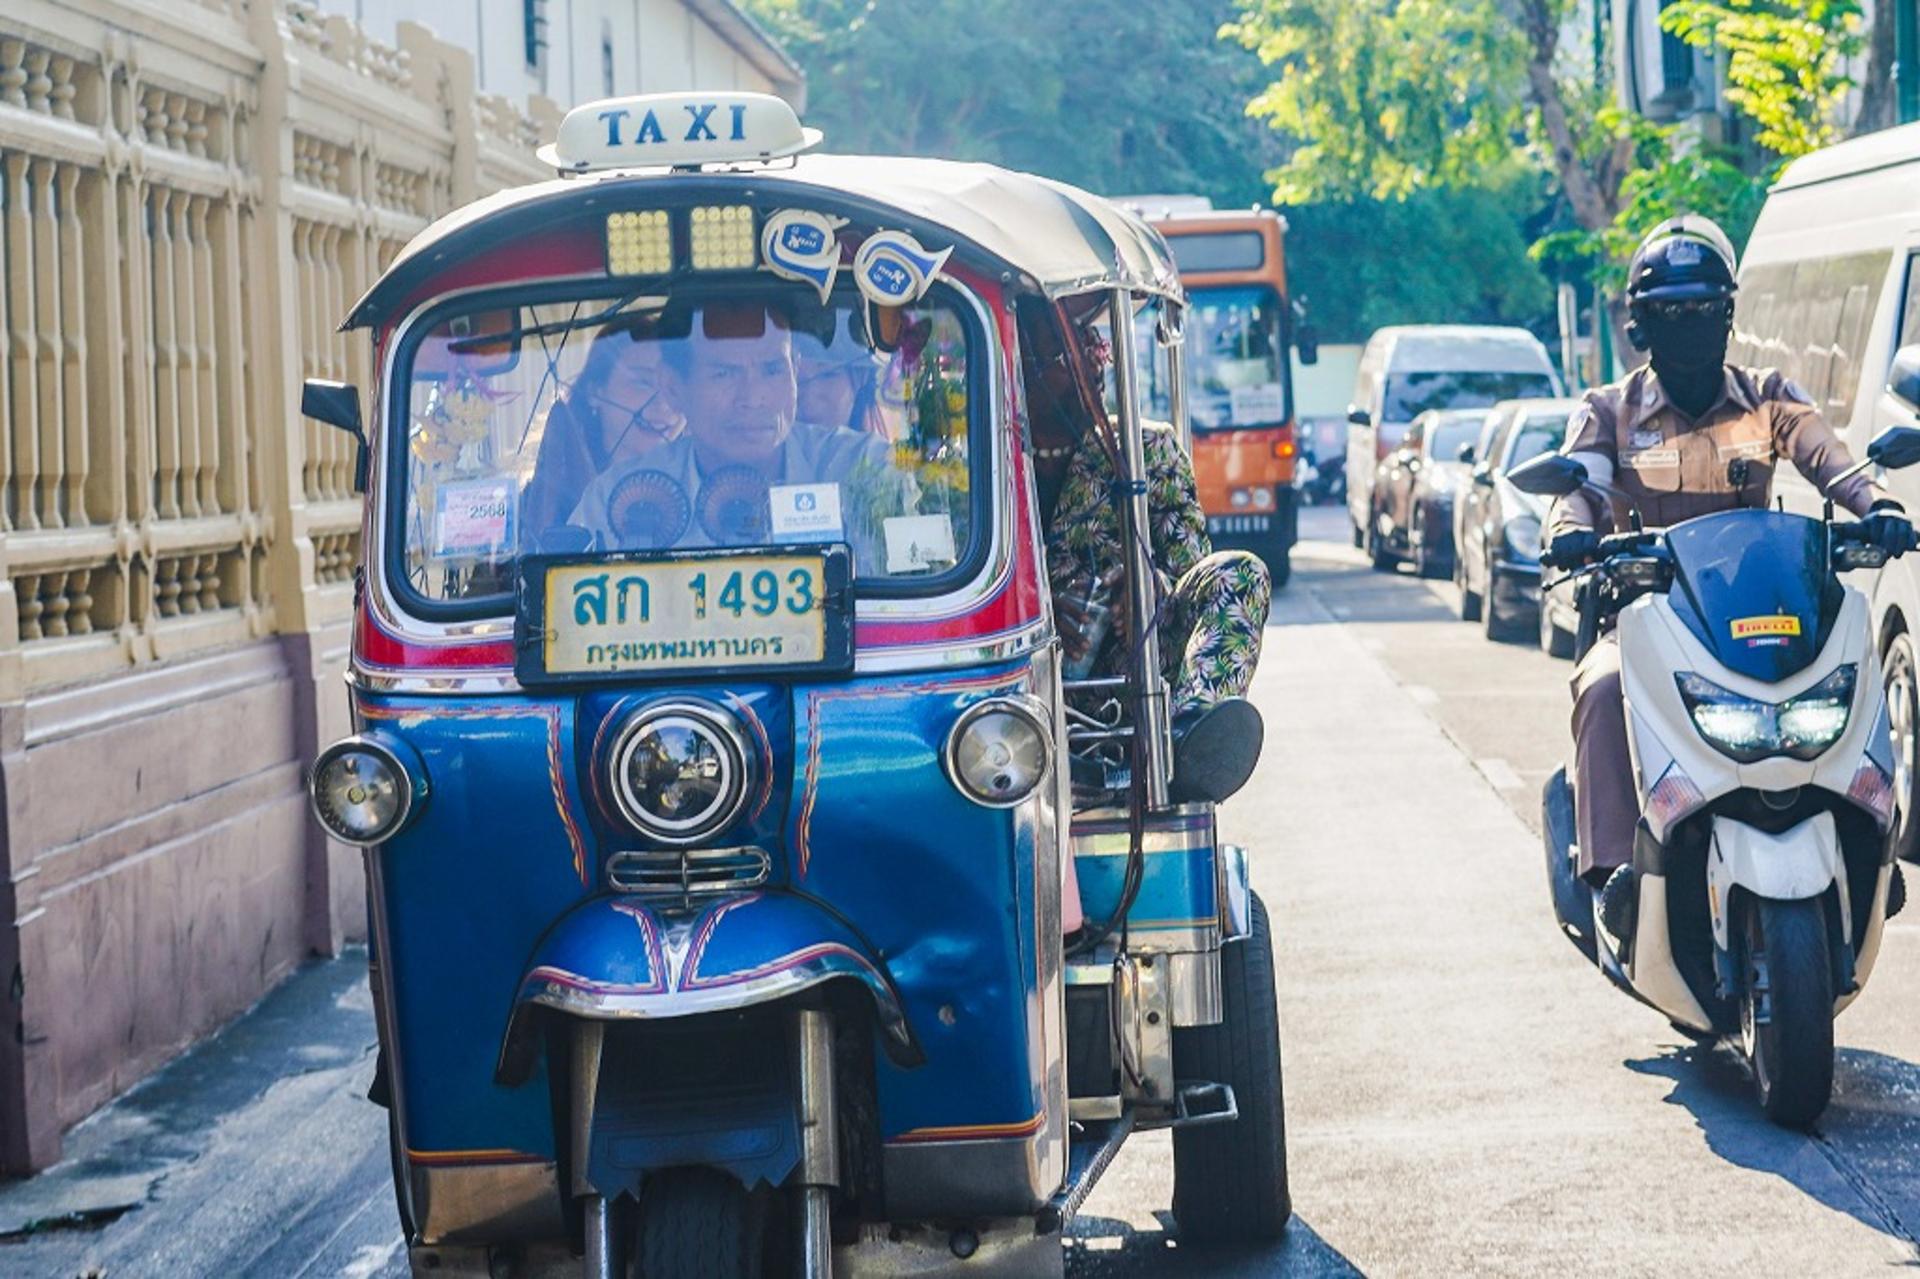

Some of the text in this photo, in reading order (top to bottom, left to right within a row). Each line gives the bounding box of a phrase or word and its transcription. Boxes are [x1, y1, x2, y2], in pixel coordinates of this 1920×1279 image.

[598, 104, 746, 146] TAXI
[573, 568, 813, 626] สก 1493
[586, 636, 783, 670] กรุงเทพมหานคร
